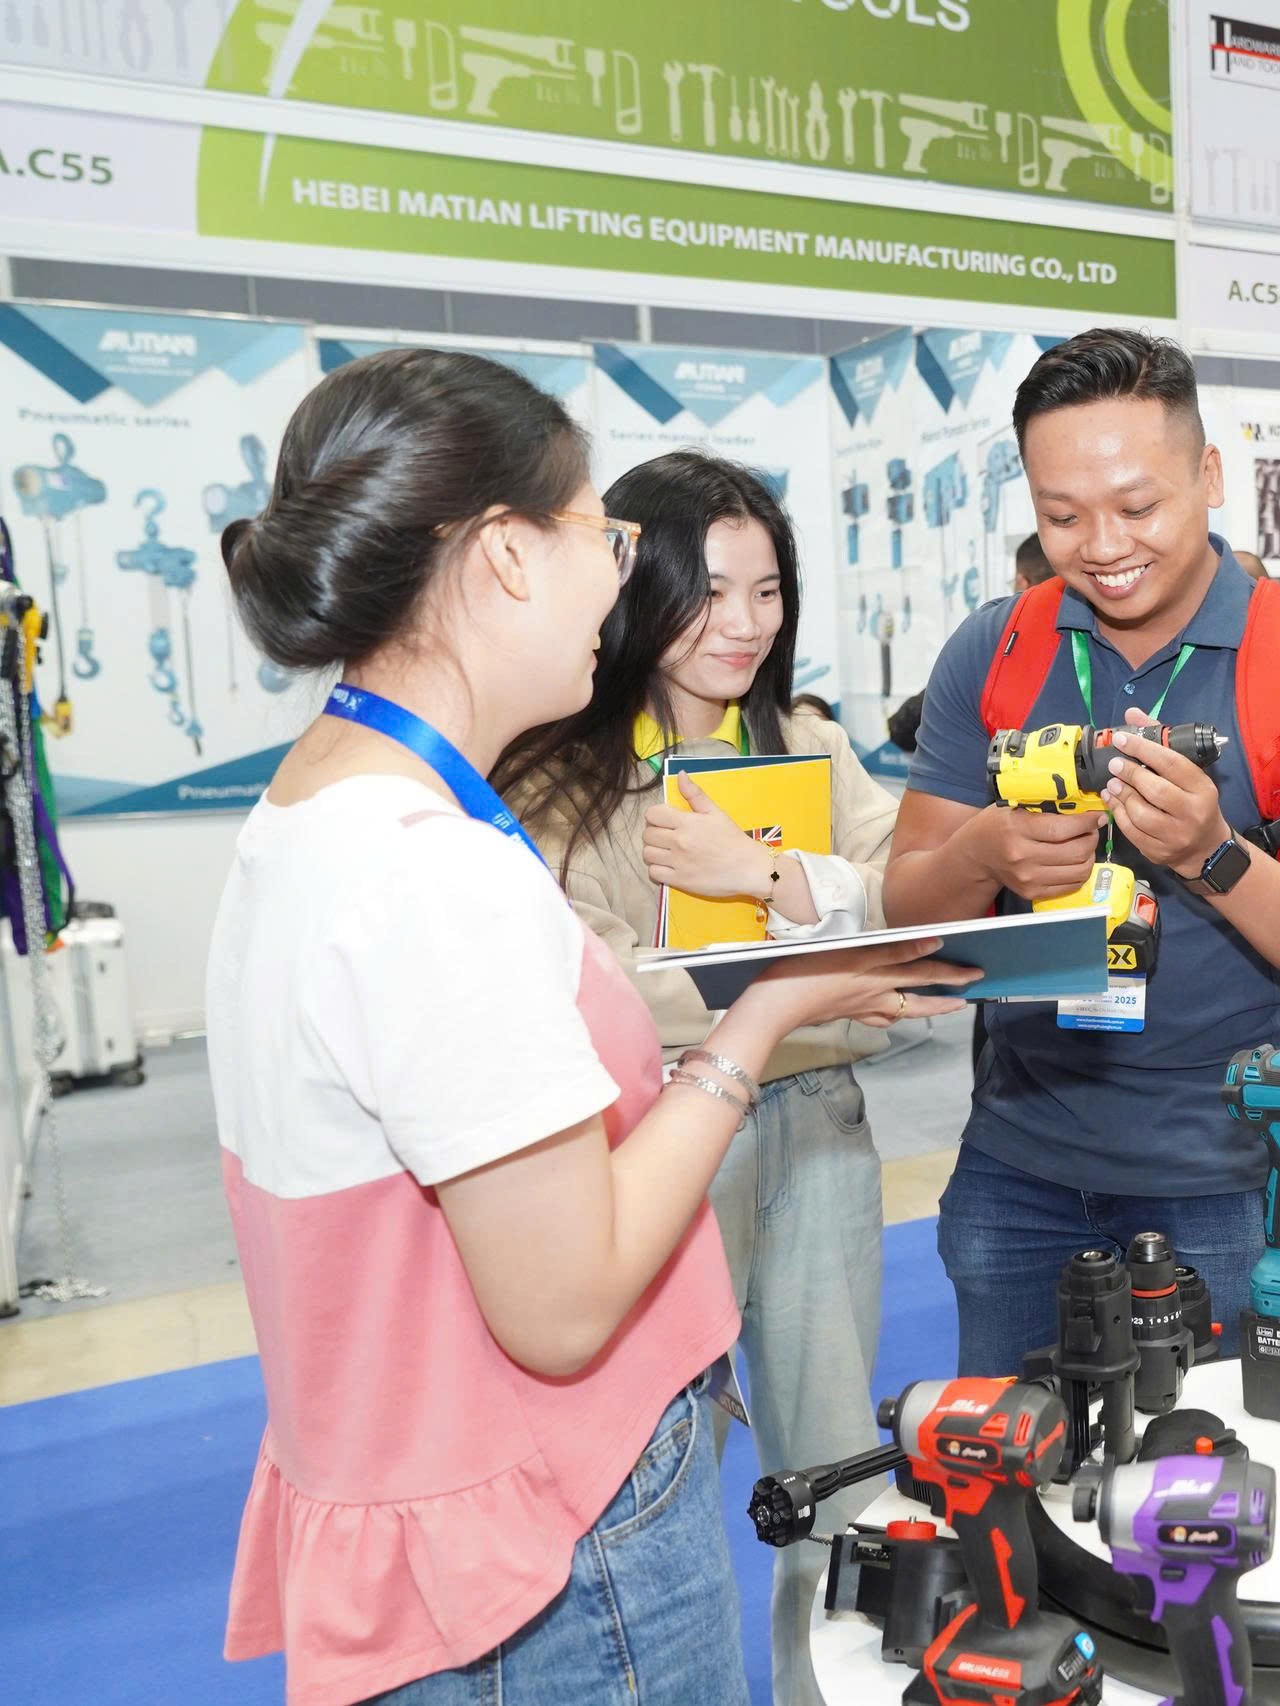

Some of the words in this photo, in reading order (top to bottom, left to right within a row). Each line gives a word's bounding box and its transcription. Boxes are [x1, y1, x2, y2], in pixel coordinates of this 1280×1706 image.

[292, 178, 390, 214] HEBEI
[398, 189, 522, 227] MATIAN
[529, 205, 644, 240] LIFTING
[649, 216, 808, 256] EQUIPMENT
[815, 234, 1026, 277] MANUFACTURING
[1030, 256, 1074, 284] CO.,
[1078, 261, 1117, 284] LTD
[1114, 995, 1137, 1005] 2025
